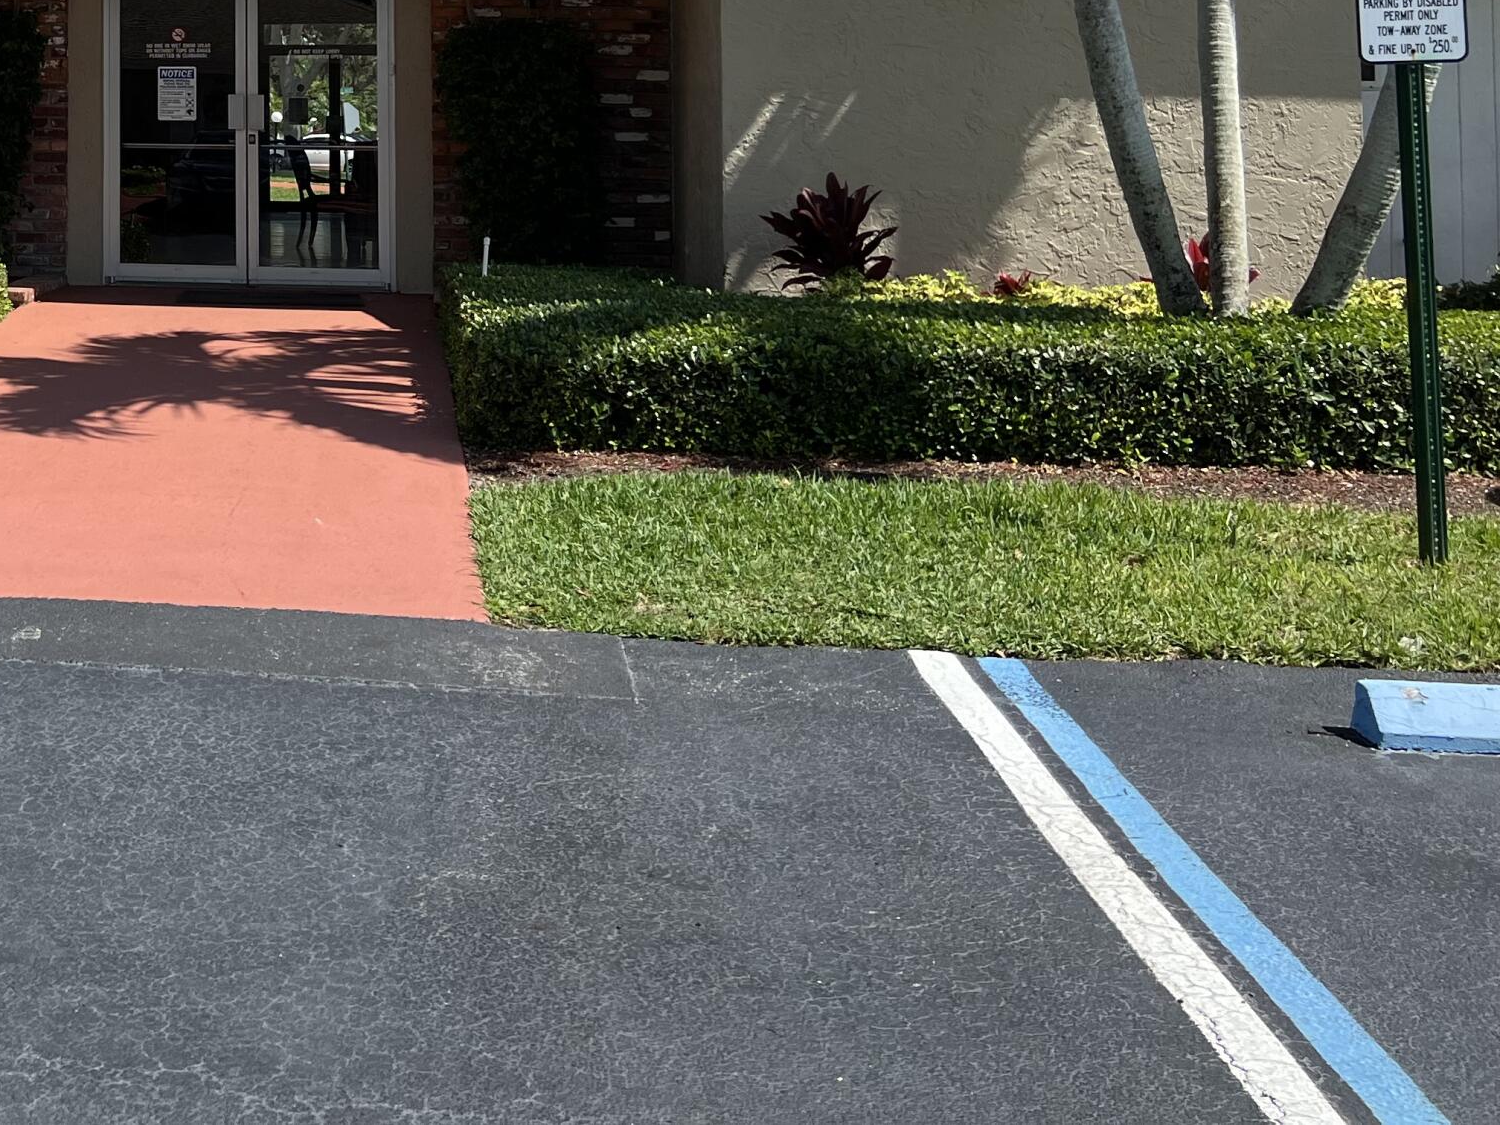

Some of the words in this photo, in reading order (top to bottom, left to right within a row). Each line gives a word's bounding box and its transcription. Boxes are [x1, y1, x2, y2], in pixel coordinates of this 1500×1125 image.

[1383, 10, 1414, 21] PERMIT
[1417, 9, 1439, 20] ONLY
[1377, 25, 1421, 36] TOW-AWAY
[1425, 24, 1448, 35] ZONE
[1368, 44, 1374, 55] &
[1378, 44, 1397, 55] FINE
[1401, 43, 1412, 54] UP
[1415, 43, 1426, 53] TO
